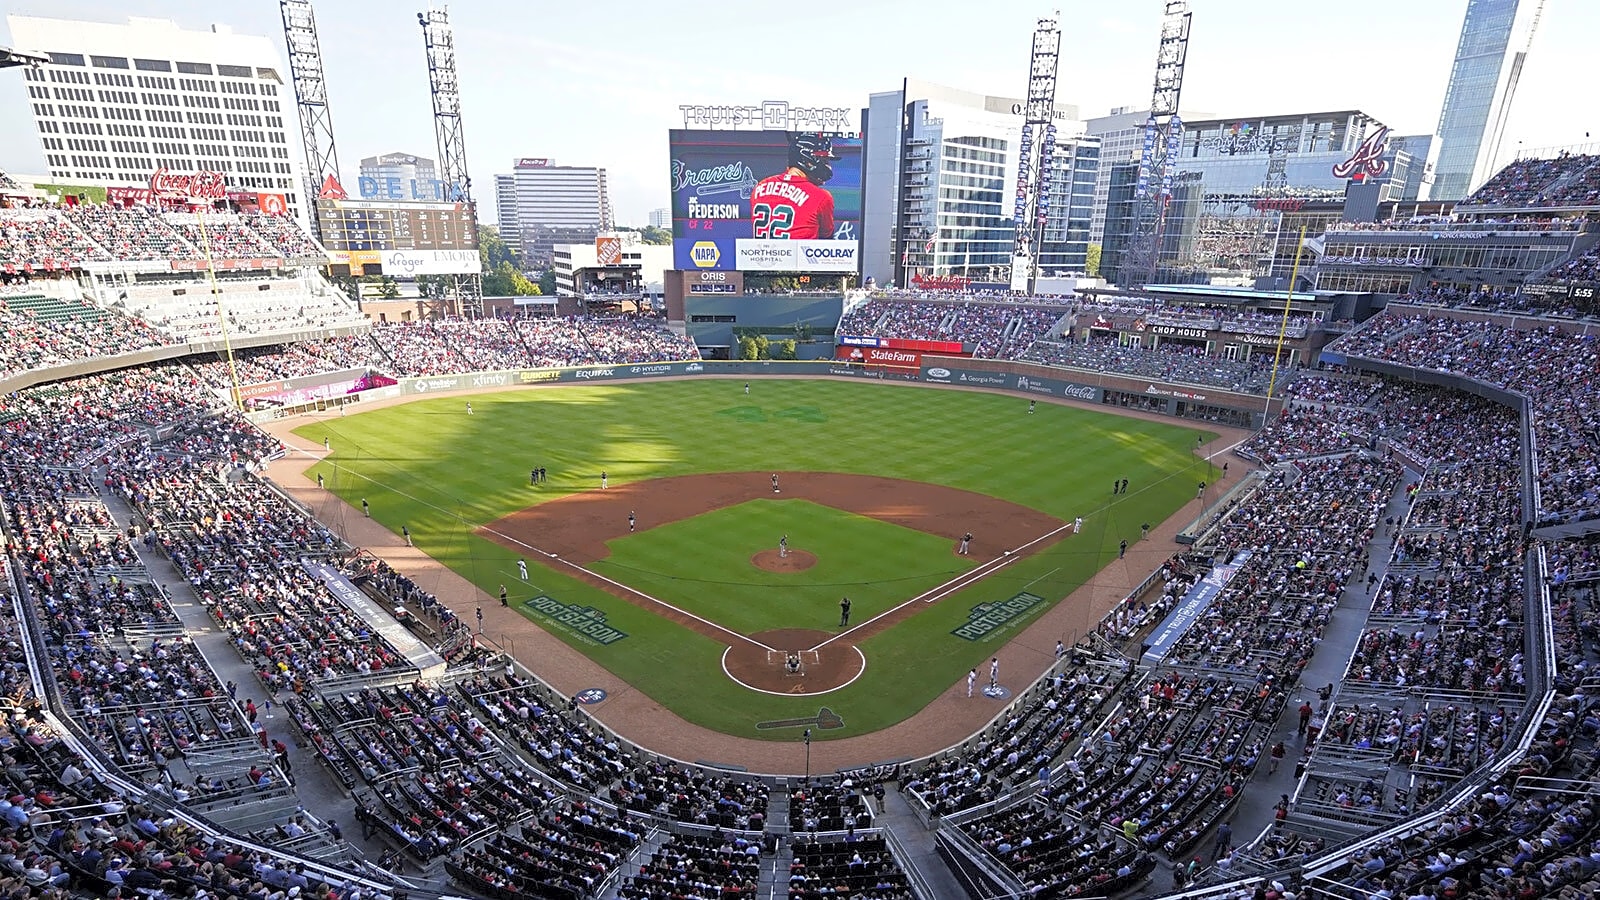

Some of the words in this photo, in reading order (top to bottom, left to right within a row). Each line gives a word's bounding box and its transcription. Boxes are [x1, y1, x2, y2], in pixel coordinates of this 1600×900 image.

[679, 105, 756, 125] TRUIST
[794, 107, 850, 126] PARK
[671, 160, 742, 192] Braves
[358, 176, 467, 201] DELTA
[754, 182, 809, 206] PEDERSON
[688, 204, 739, 219] PEDERSON
[703, 220, 713, 229] 22
[753, 203, 795, 240] 22
[433, 252, 477, 261] EMORY
[694, 247, 717, 260] NAPA
[741, 249, 792, 257] NORTHSIDE
[805, 248, 854, 258] COOLRAY
[701, 272, 725, 280] ORIS
[1574, 288, 1593, 298] 5:55
[1152, 325, 1175, 335] CHOP
[1177, 328, 1207, 338] HOUSE
[473, 373, 507, 387] xfinity
[576, 369, 615, 379] EQUIFAX
[968, 375, 988, 384] Georgia
[527, 596, 624, 643] POSTSEASON
[955, 593, 1041, 640] POSTSEASON
